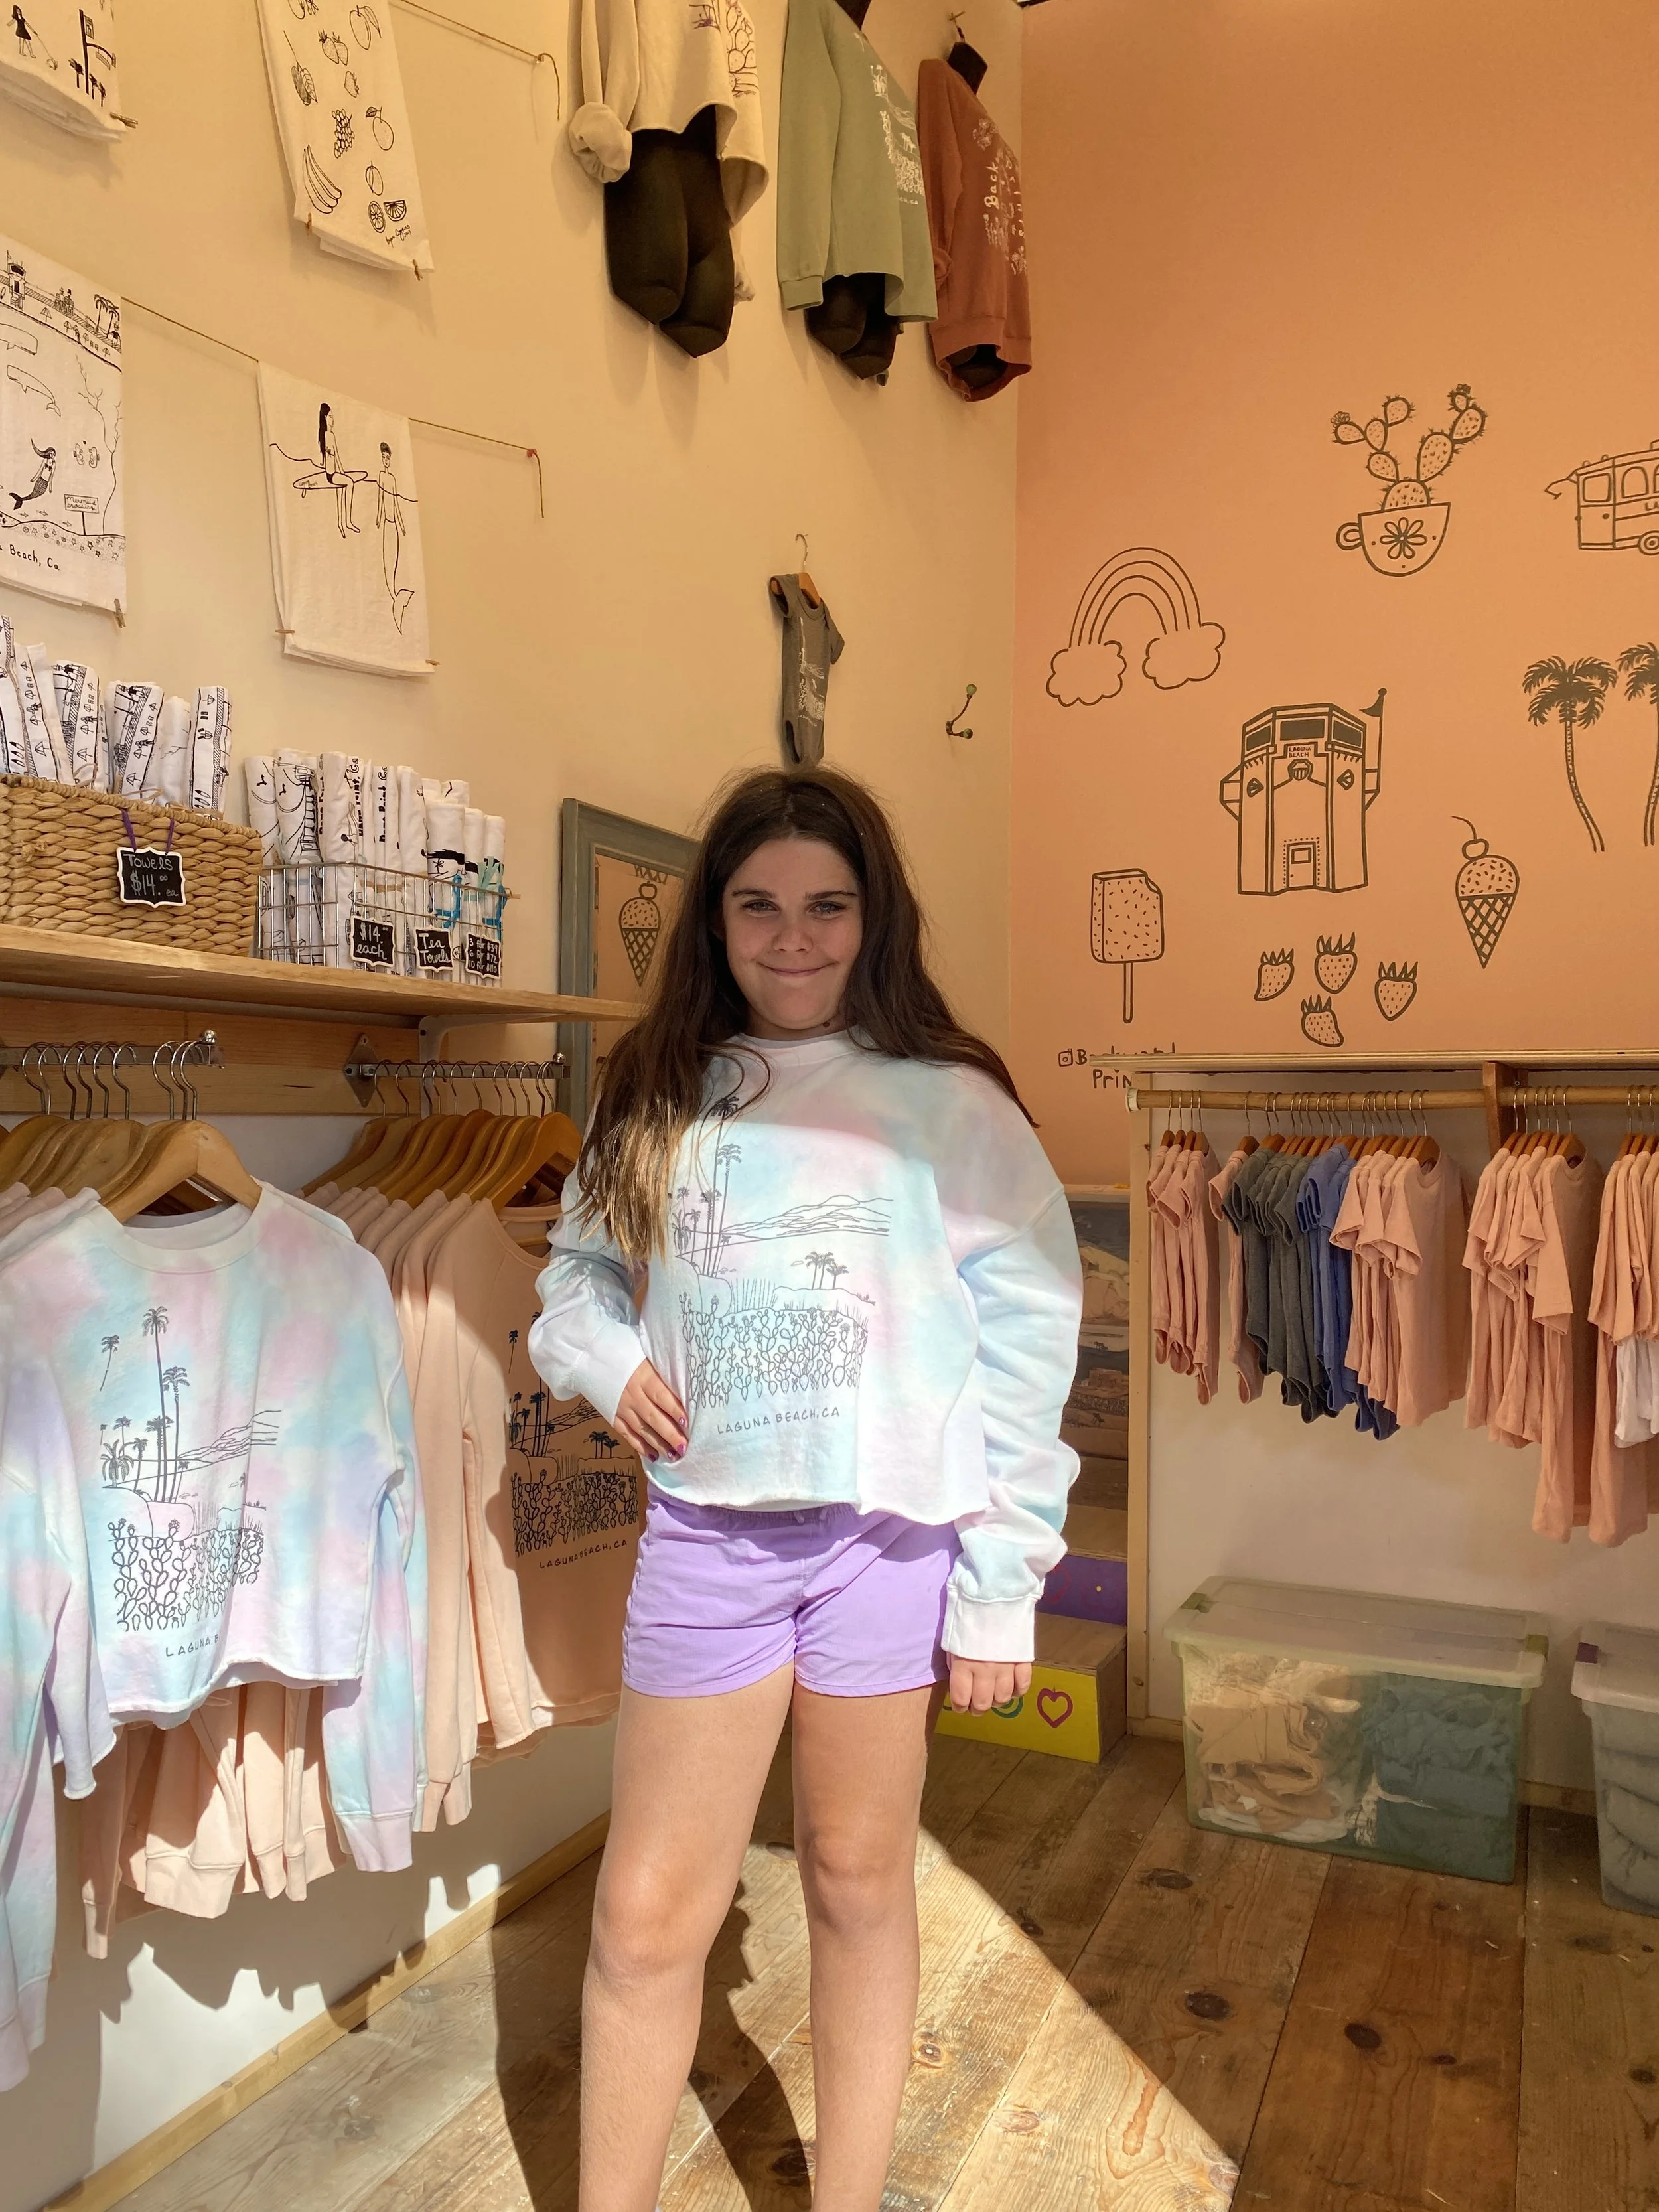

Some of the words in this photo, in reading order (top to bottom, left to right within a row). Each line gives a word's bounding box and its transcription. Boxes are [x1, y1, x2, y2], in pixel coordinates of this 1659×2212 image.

[9, 544, 41, 567] Beach,
[47, 557, 60, 571] Ca
[123, 853, 173, 871] Towels
[419, 933, 445, 950] Tea
[469, 938, 474, 946] 3
[476, 938, 485, 949] for
[487, 941, 498, 954] $39
[356, 944, 387, 960] each
[419, 949, 451, 964] Towels
[476, 949, 485, 959] for
[487, 952, 498, 964] $72
[469, 960, 475, 968] 10
[476, 960, 485, 970] for
[717, 1416, 771, 1434] LAGUNA
[540, 1554, 578, 1569] LAGUNA
[166, 1636, 211, 1657] LAGUNA
